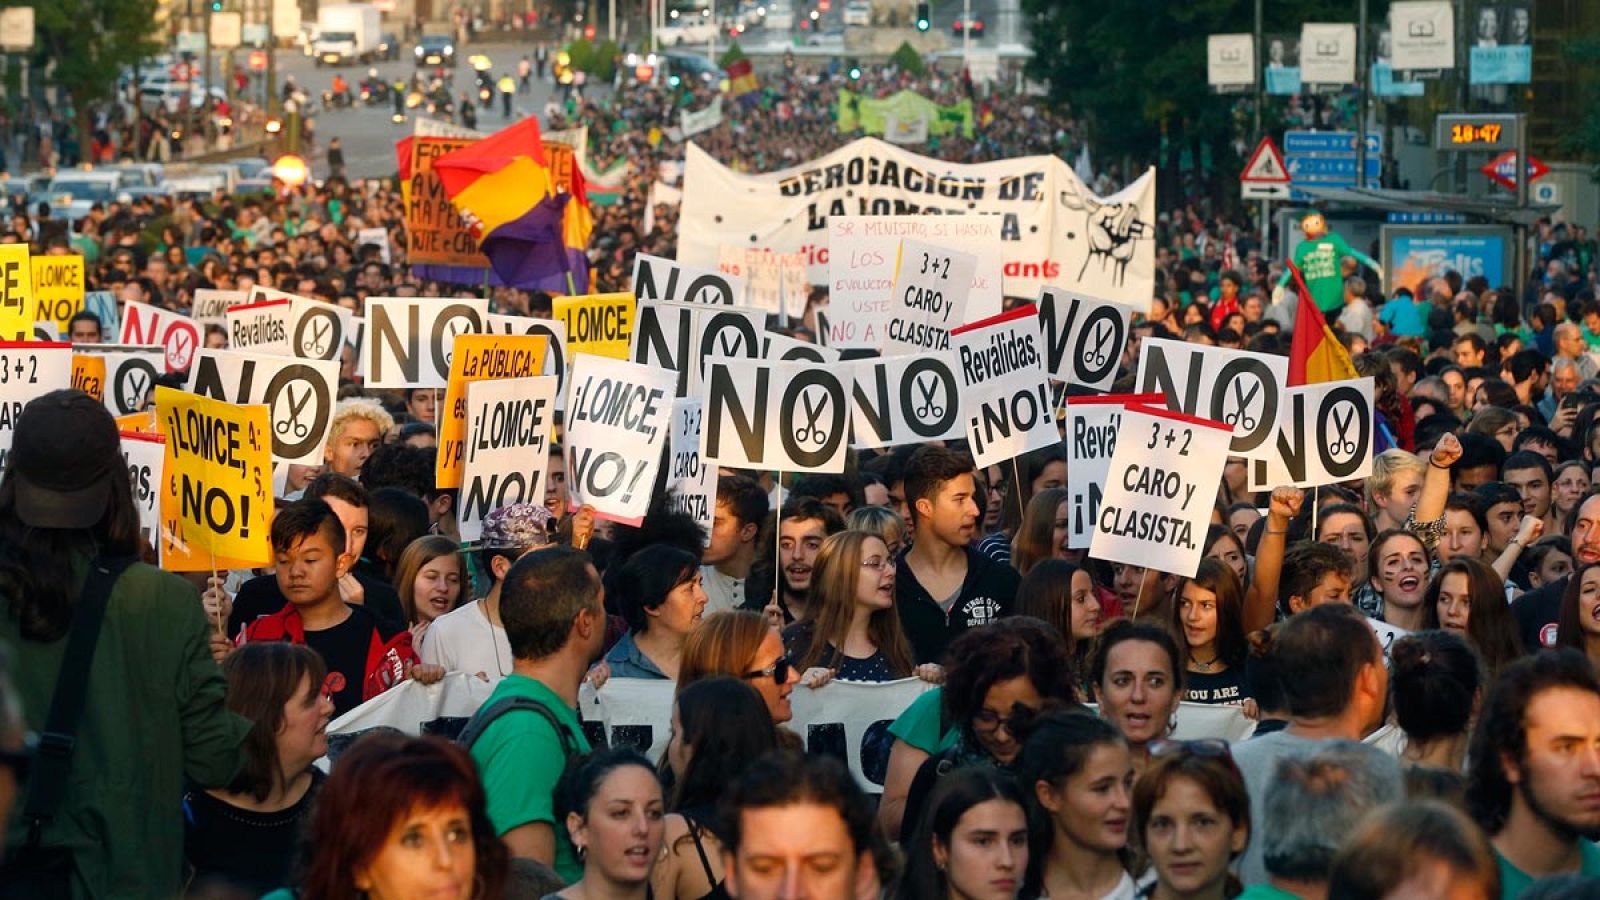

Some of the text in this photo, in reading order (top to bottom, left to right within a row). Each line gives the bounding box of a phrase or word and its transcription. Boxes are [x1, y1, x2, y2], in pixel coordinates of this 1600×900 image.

[1452, 123, 1502, 144] 18:47
[779, 156, 1045, 202] DEROGACIÓN DE
[807, 198, 846, 231] LA
[635, 259, 734, 306] NO
[851, 250, 884, 269] LOS
[1004, 258, 1060, 279] ants
[0, 261, 25, 316] E,
[852, 301, 889, 313] USTE
[904, 285, 952, 322] CARO y
[122, 304, 200, 373] NO
[233, 314, 290, 347] Reválidas,
[371, 303, 482, 384] NO
[635, 306, 759, 398] NO
[832, 320, 857, 343] NO
[864, 323, 876, 342] A
[889, 317, 953, 351] CLASISTA.
[959, 328, 1041, 387] Reválidas,
[1039, 291, 1124, 384] NO
[463, 342, 536, 377] La PÚBLICA:
[193, 355, 331, 460] NO
[568, 375, 665, 445] ¡LOMCE,
[706, 363, 846, 469] NO
[849, 357, 959, 445] NO
[971, 383, 1051, 455] ¡NO!
[1144, 345, 1279, 453] NO
[168, 406, 247, 479] ¡LOMCE,
[470, 398, 547, 463] ¡LOMCE,
[1254, 386, 1370, 486] NO
[462, 469, 541, 522] NO!
[569, 445, 649, 505] NO!
[674, 451, 706, 486] CARO y
[1123, 463, 1197, 511] CARO y
[182, 473, 250, 539] NO!
[1099, 506, 1197, 550] CLASISTA.
[1212, 686, 1240, 699] ARE
